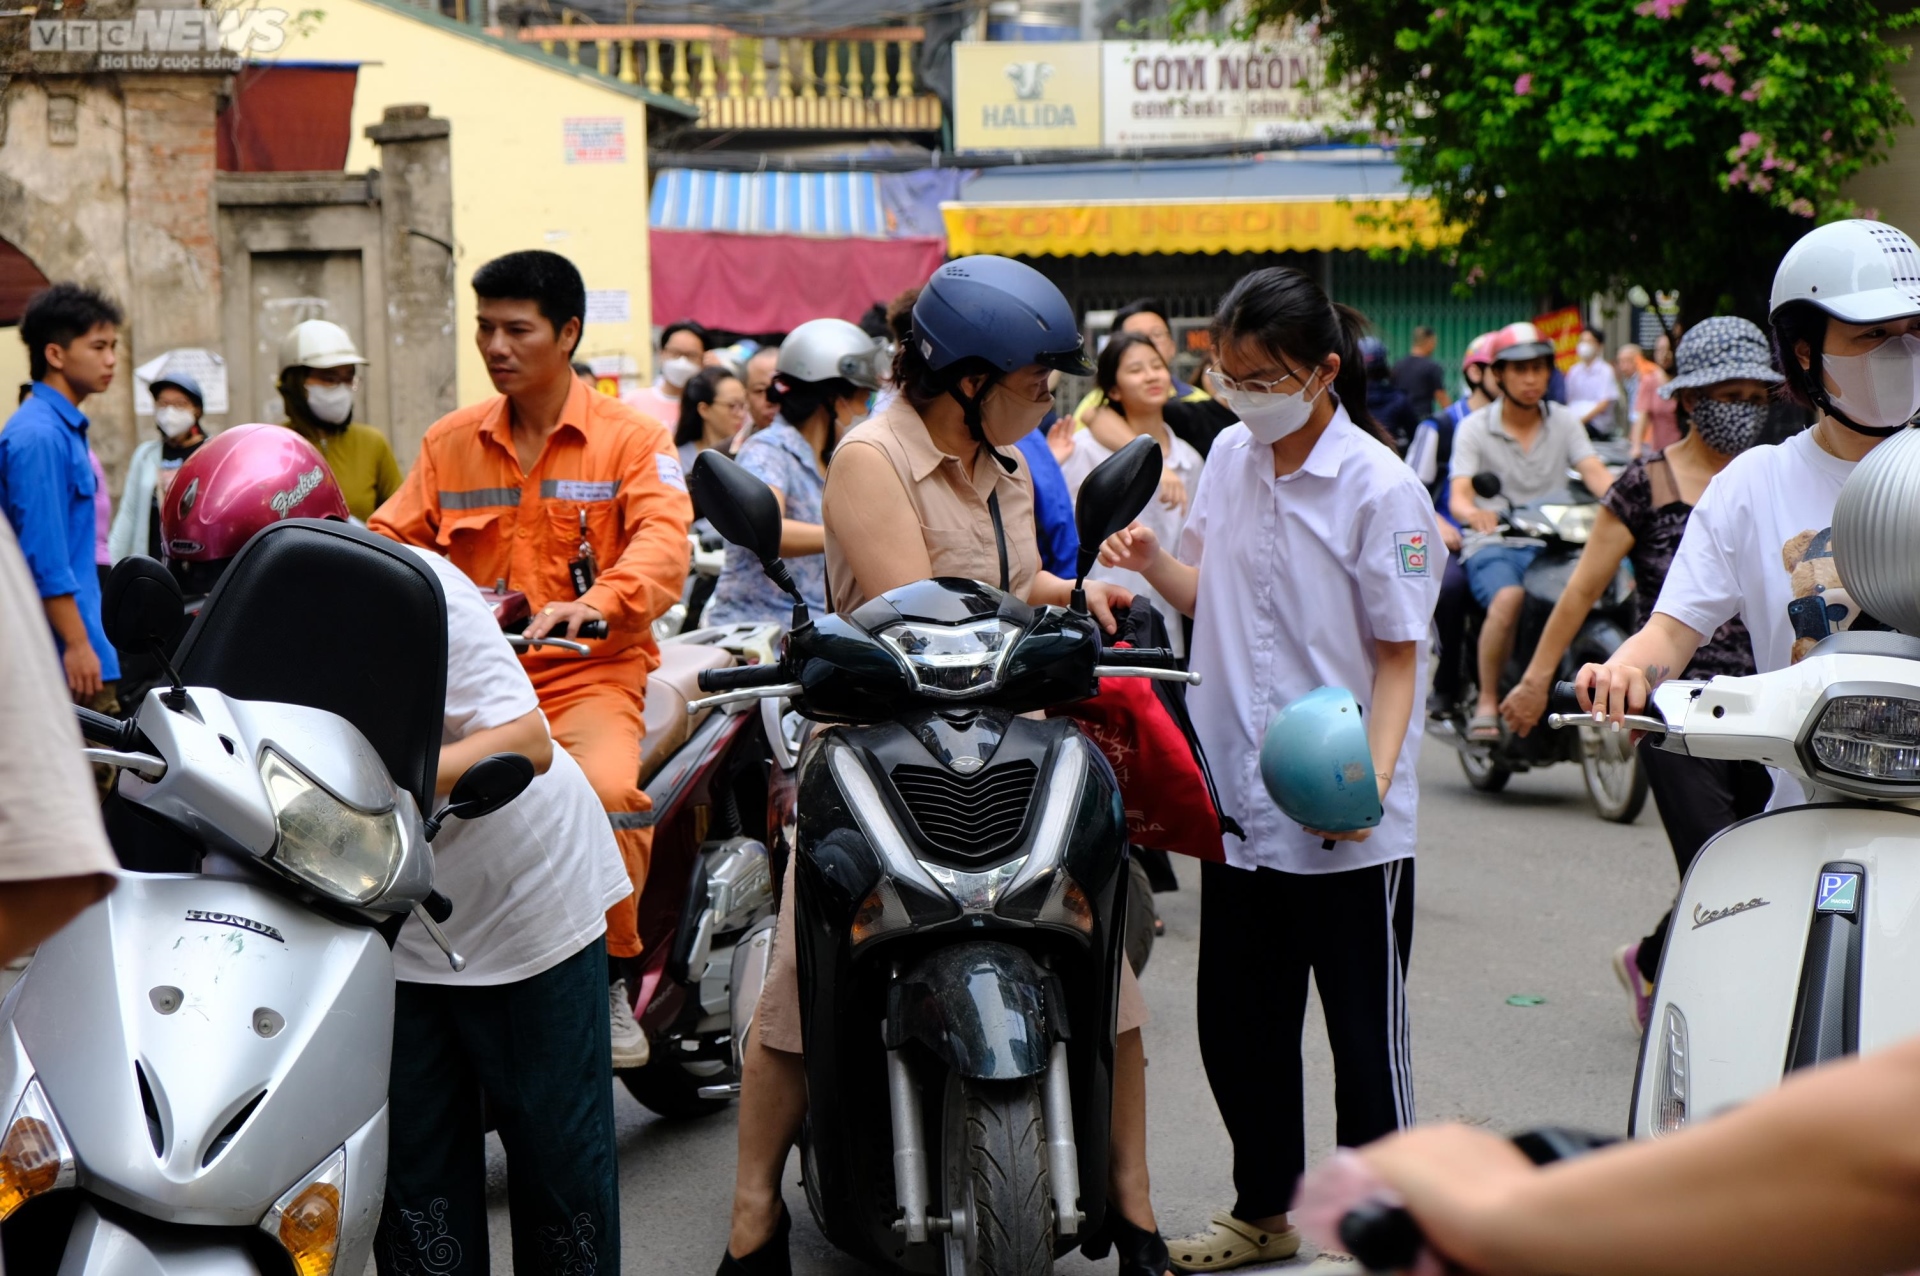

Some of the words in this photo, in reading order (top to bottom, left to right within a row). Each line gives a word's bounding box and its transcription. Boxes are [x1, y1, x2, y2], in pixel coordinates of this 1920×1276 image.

[1218, 56, 1311, 92] NGON
[981, 104, 1077, 128] HALIDA
[1139, 206, 1322, 236] NGON
[1821, 875, 1842, 898] P
[185, 909, 285, 943] HONDA
[1692, 896, 1771, 931] Vespa
